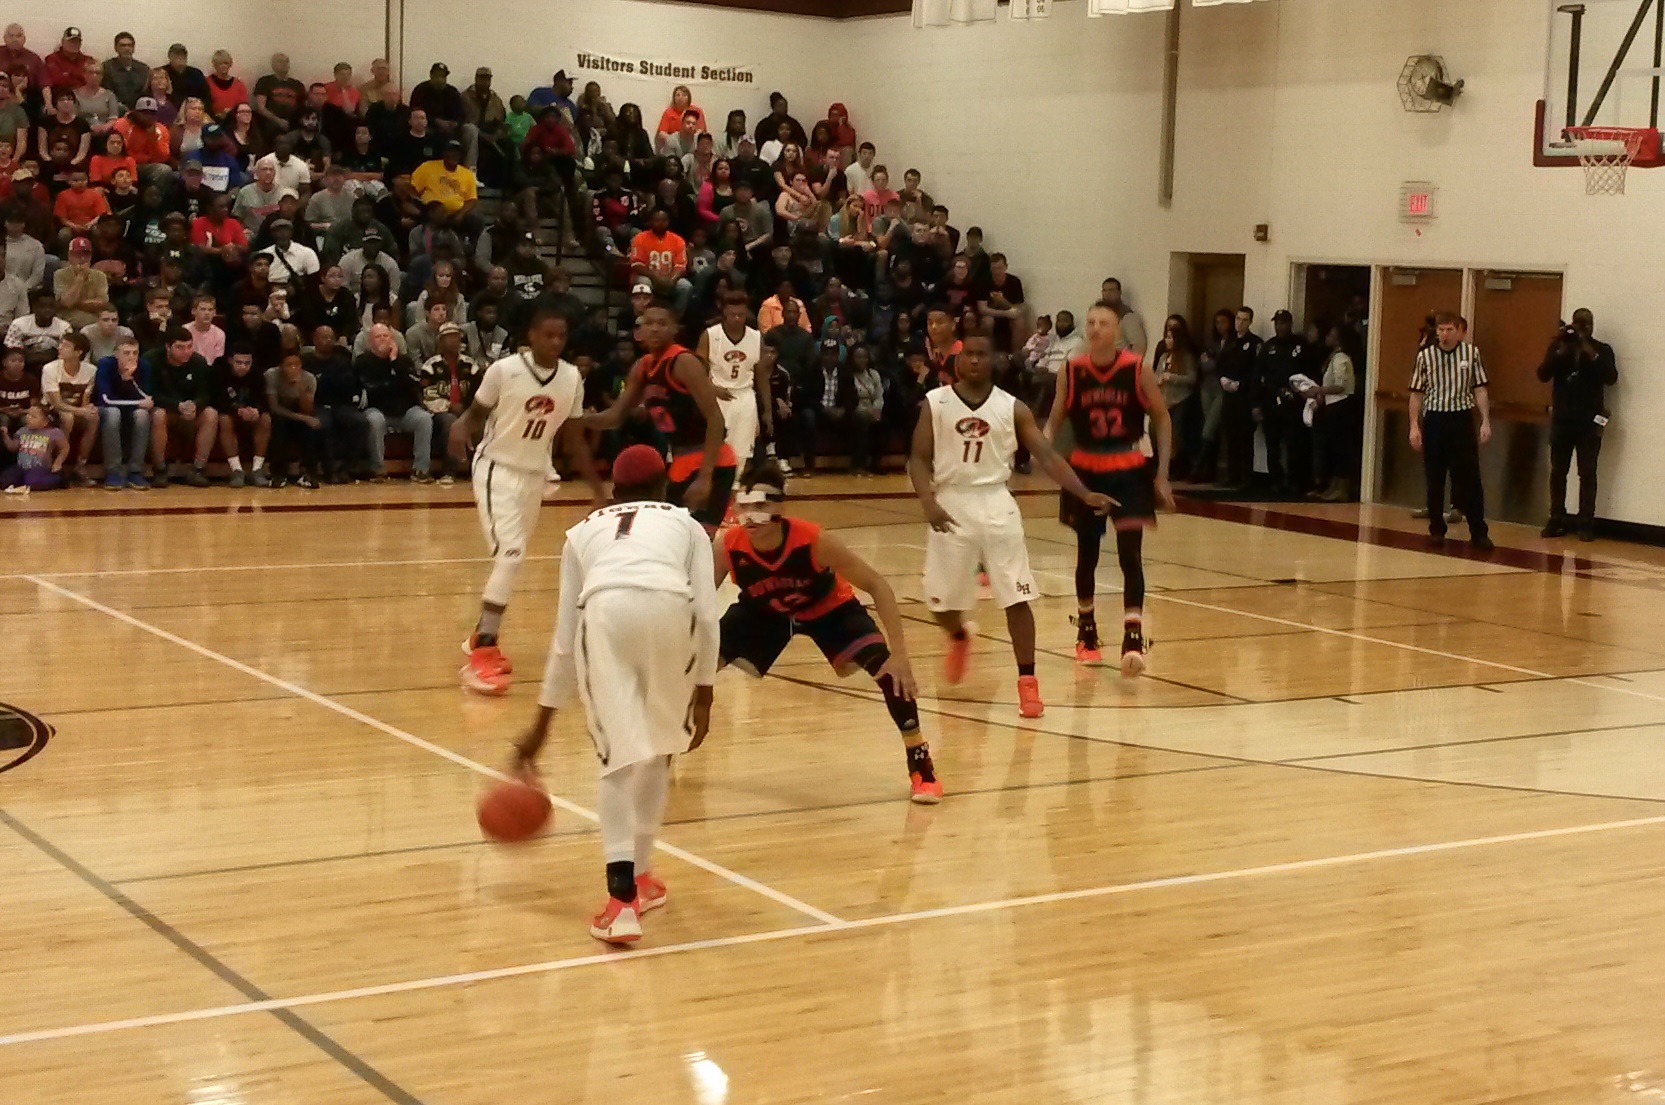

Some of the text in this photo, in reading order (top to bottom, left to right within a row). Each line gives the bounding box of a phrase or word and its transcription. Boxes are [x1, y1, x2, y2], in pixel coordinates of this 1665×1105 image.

[577, 53, 753, 83] Visitors Student Section
[731, 365, 740, 379] 5
[522, 419, 547, 440] 10
[963, 441, 983, 463] 11
[615, 511, 638, 540] 1
